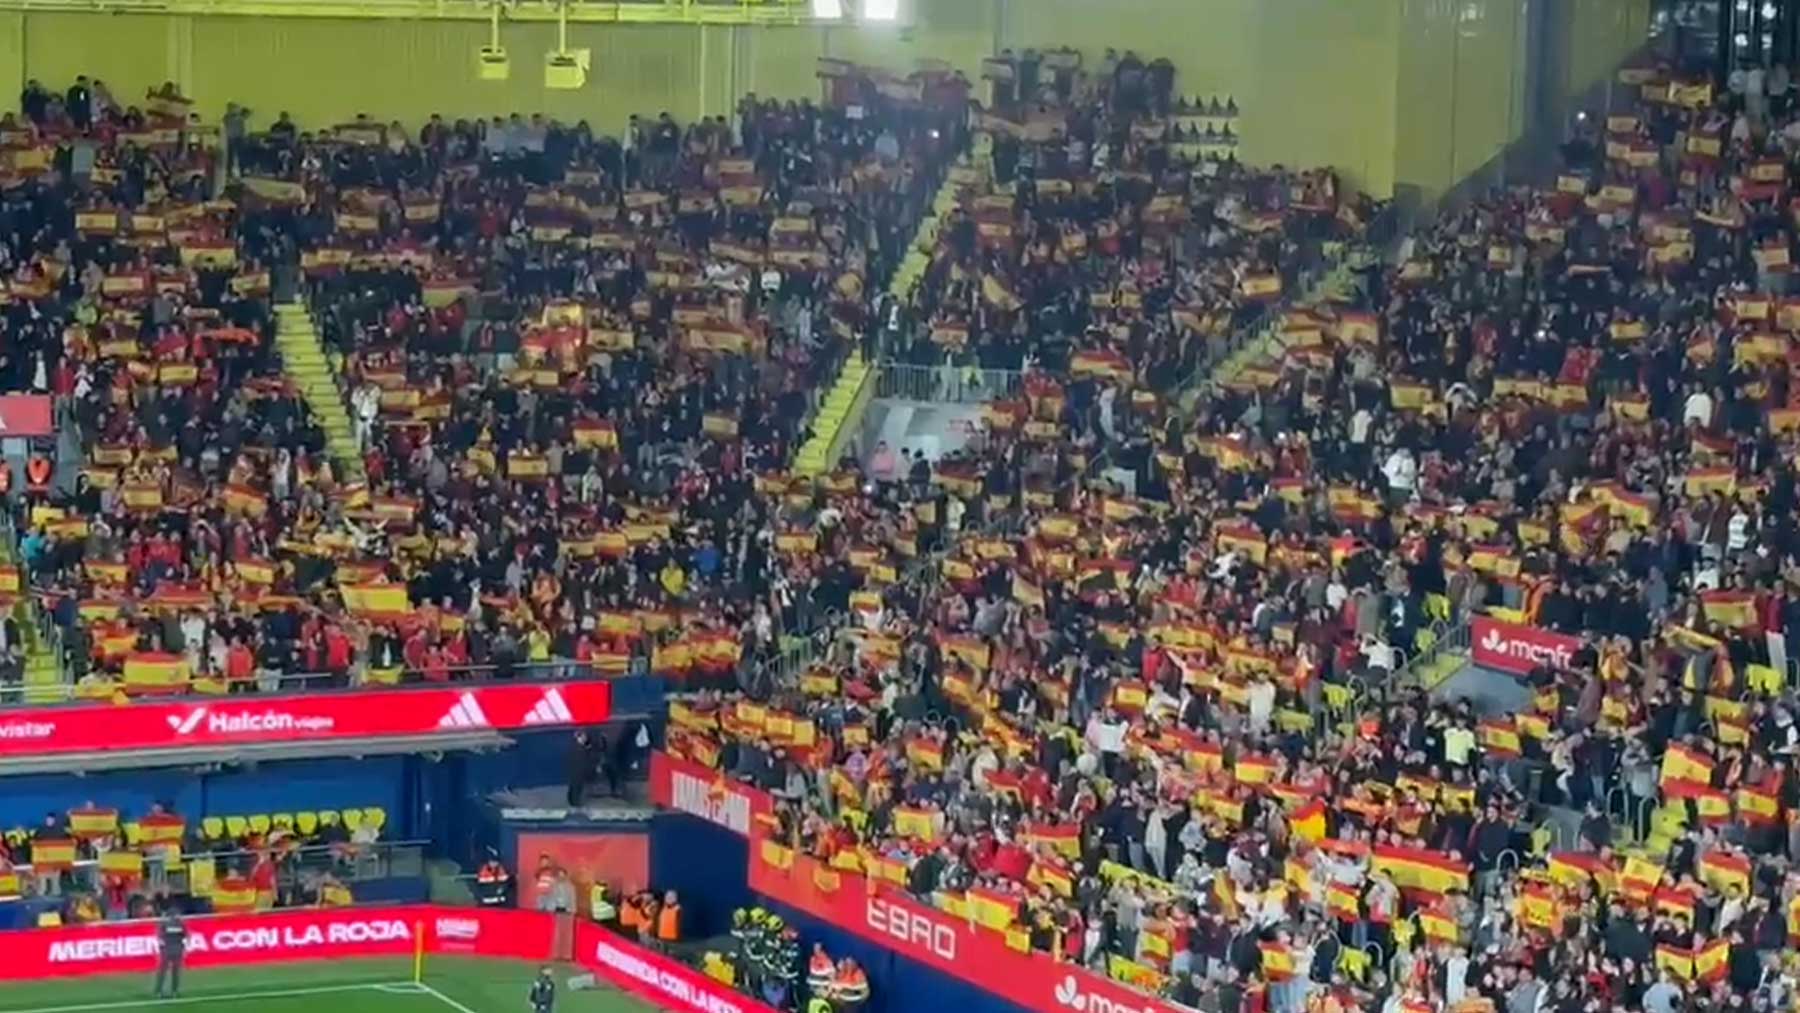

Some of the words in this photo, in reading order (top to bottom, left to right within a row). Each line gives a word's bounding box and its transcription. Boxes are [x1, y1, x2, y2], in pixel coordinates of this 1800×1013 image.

[208, 709, 292, 732] Halcón
[49, 931, 209, 962] MERIENA
[213, 928, 278, 950] CON
[285, 924, 323, 945] LA
[328, 919, 409, 943] ROJA
[868, 899, 955, 960] EBRO
